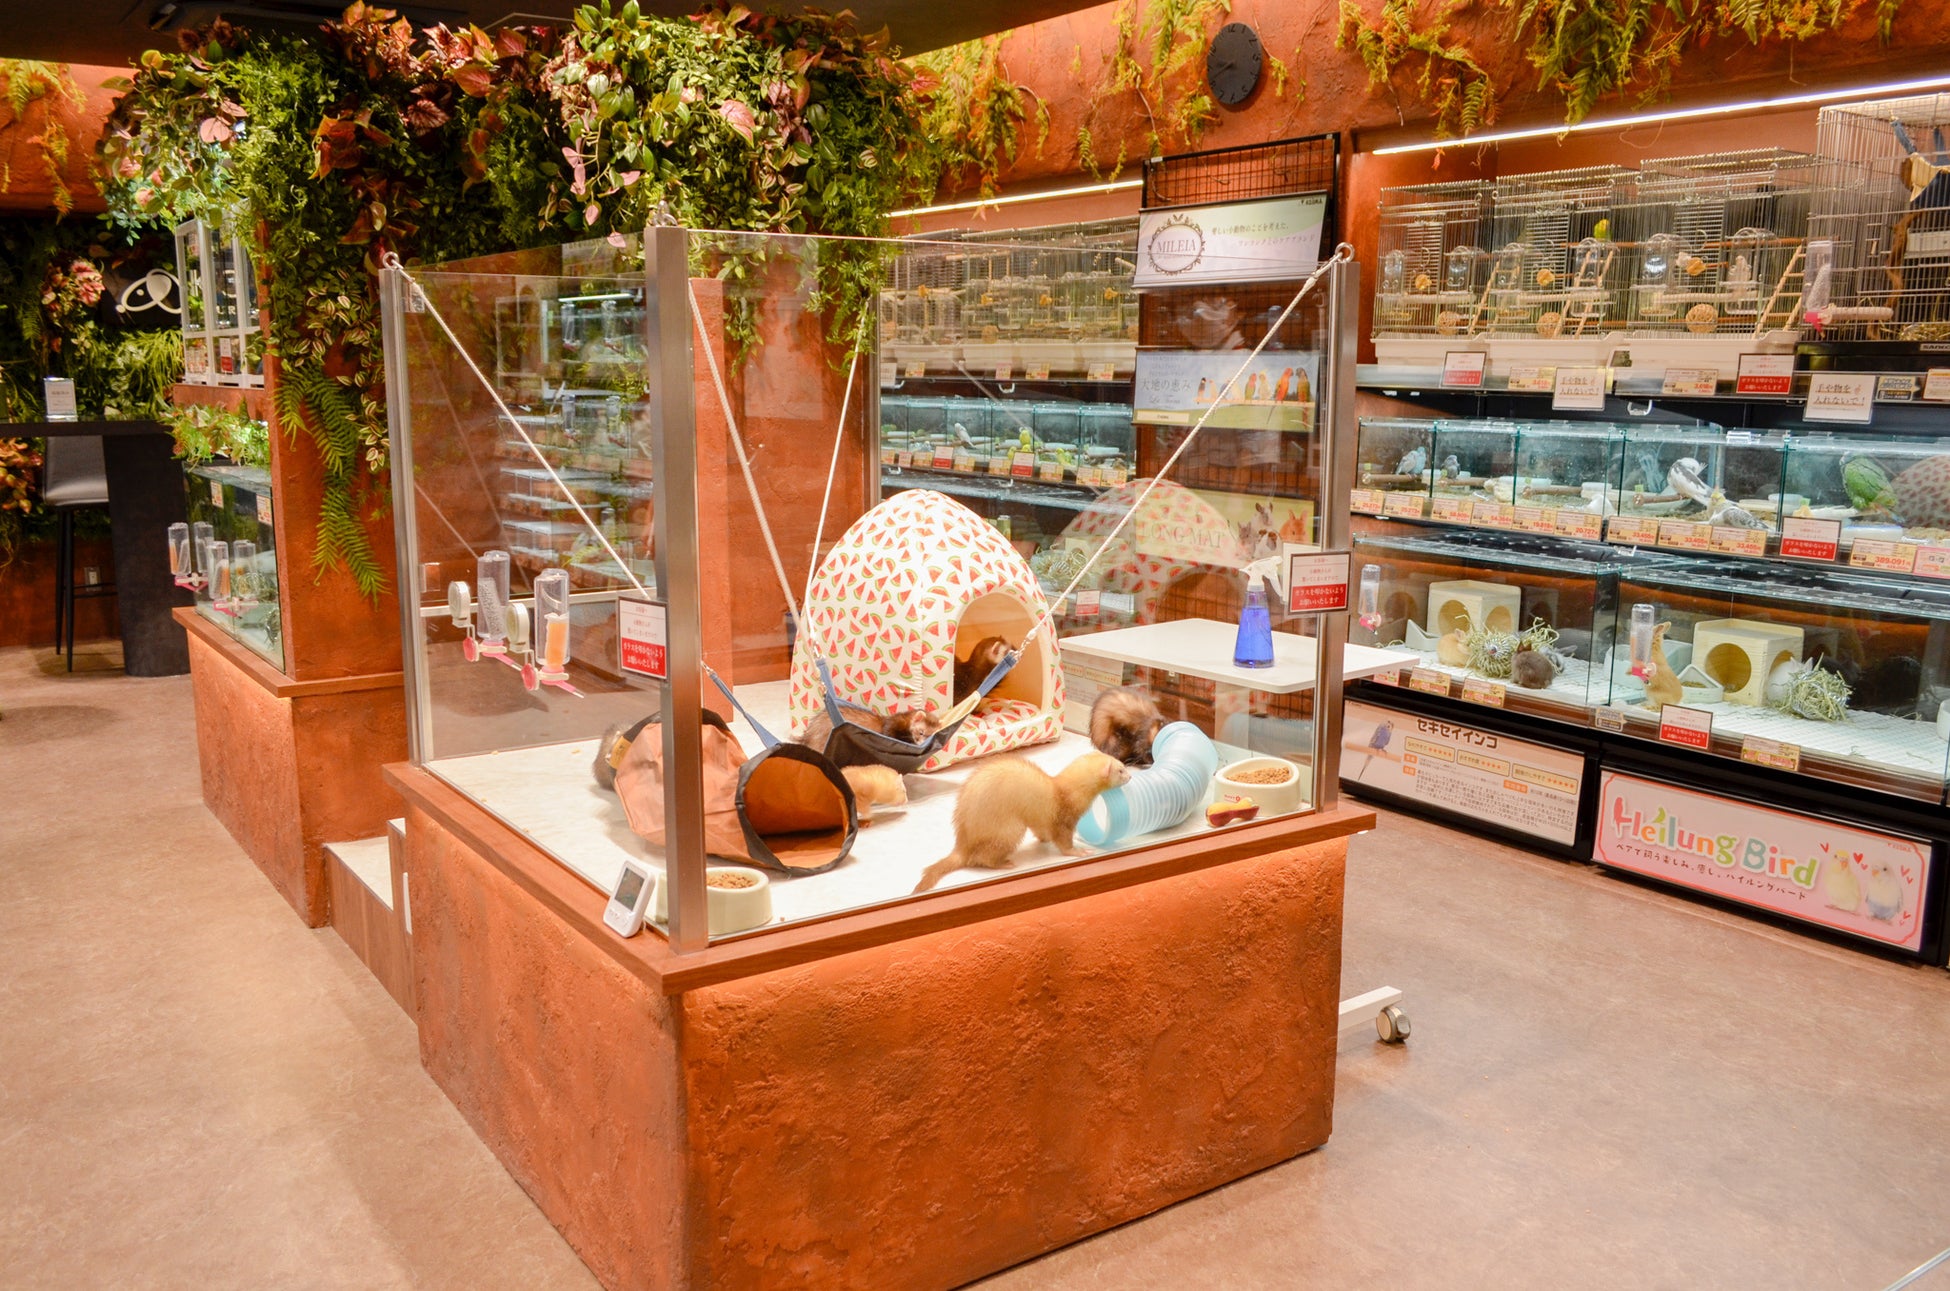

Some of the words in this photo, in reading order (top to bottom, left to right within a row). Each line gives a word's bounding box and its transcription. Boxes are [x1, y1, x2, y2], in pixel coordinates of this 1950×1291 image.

[1157, 238, 1197, 253] MILEIA
[1416, 718, 1498, 749] セキセイインコ
[1613, 796, 1737, 865] Heilung
[1743, 837, 1818, 887] Bird
